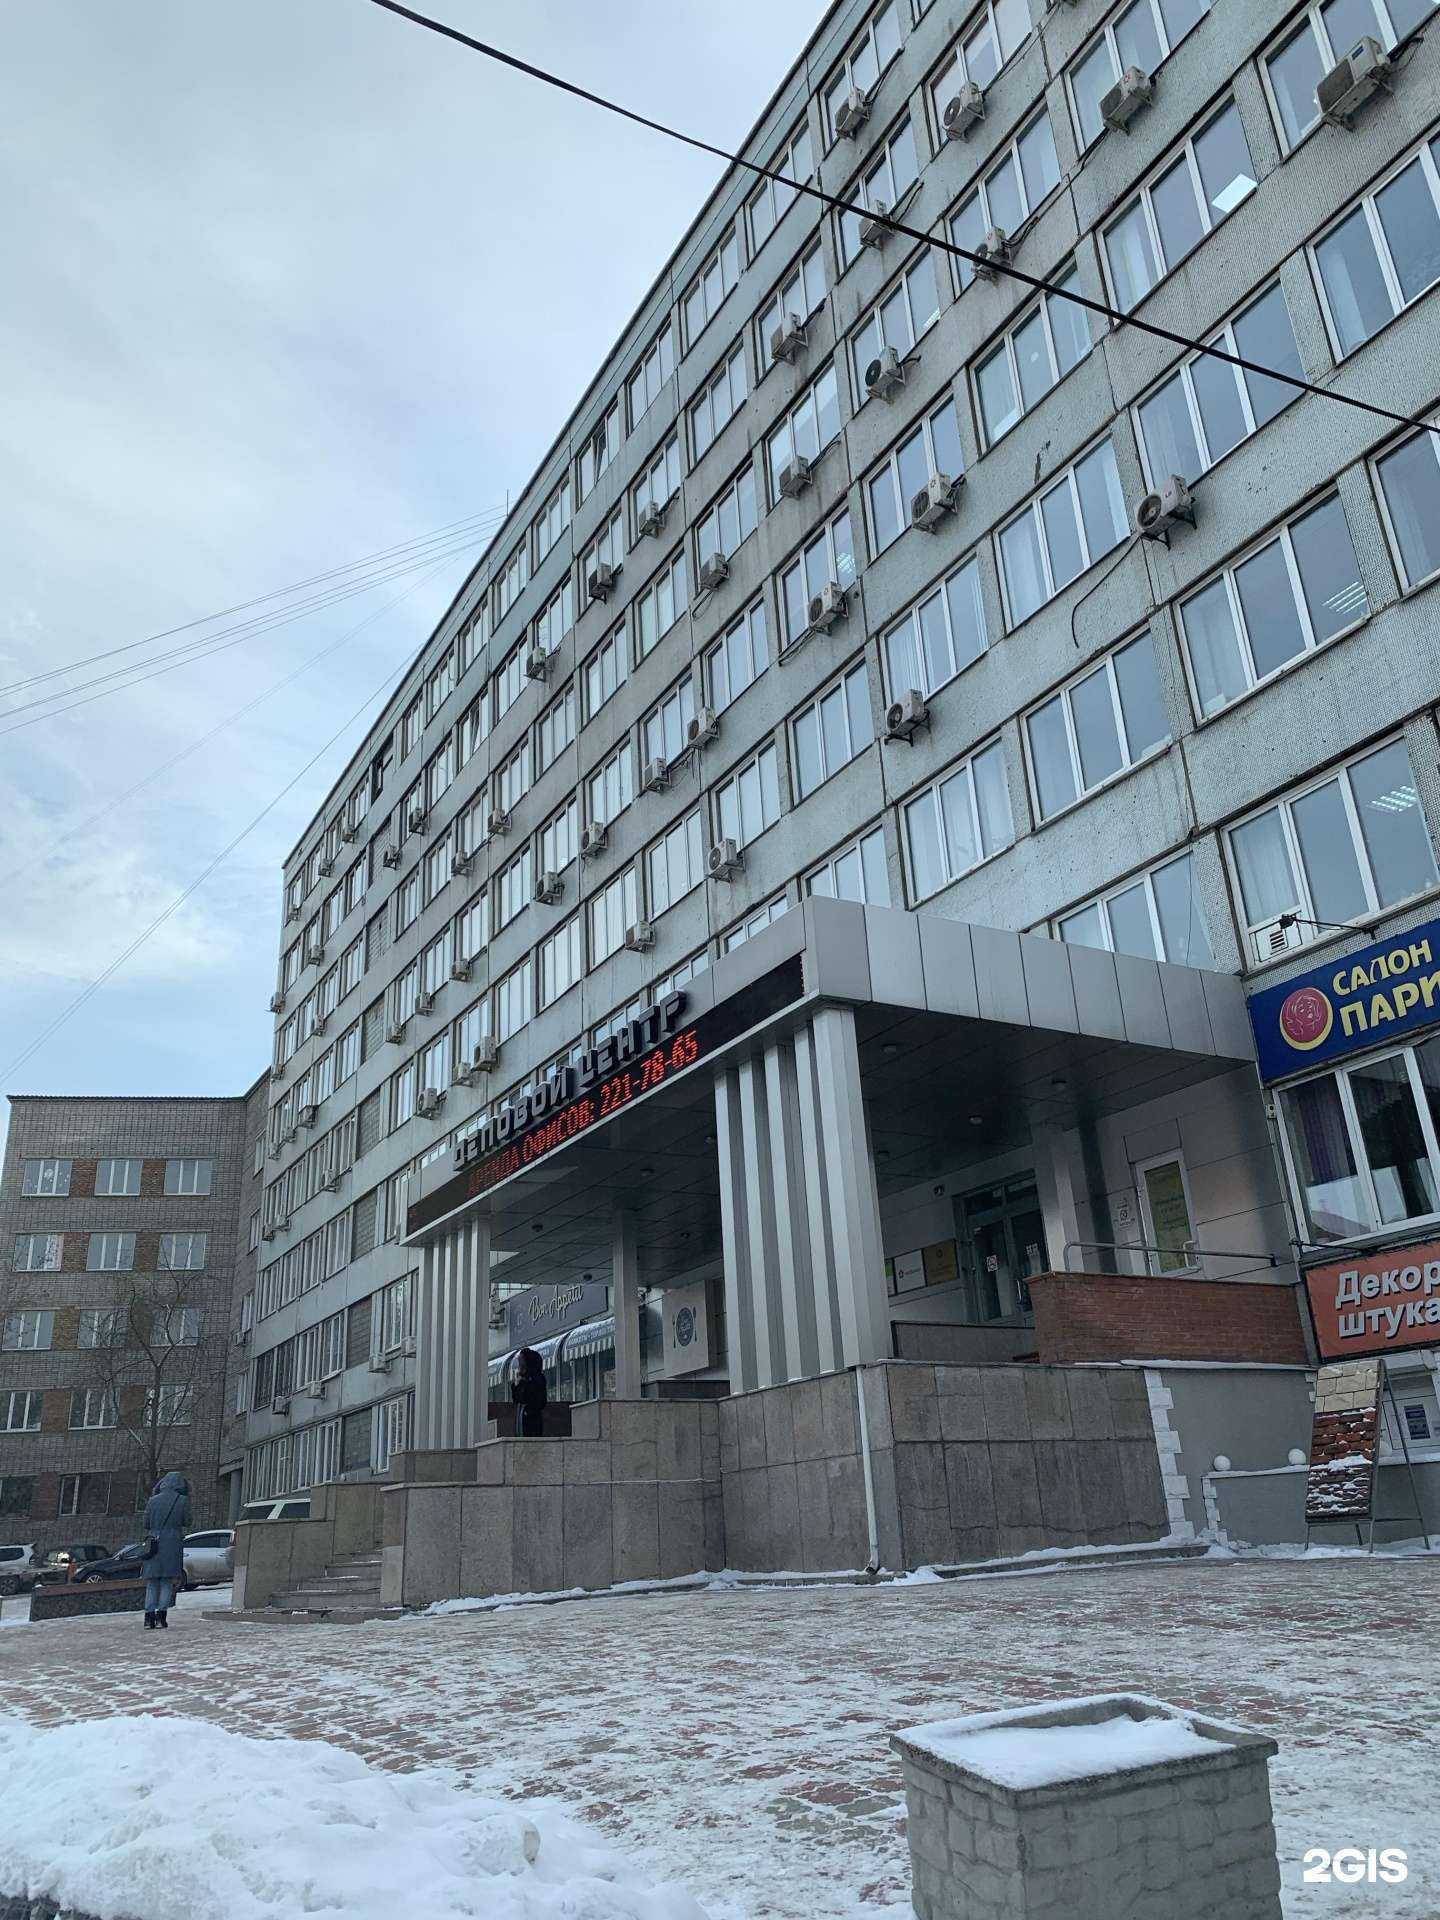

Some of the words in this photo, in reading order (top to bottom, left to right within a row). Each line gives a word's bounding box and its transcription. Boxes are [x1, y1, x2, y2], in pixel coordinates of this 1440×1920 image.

[1332, 938, 1433, 996] САЛОН
[452, 1065, 573, 1171] ДЕЛОВОЙ
[578, 988, 687, 1087] ЦЕНТР
[522, 1098, 594, 1163] ОФИСОВ:
[600, 1029, 699, 1116] 221-78-65
[1335, 1260, 1440, 1310] Декор
[1339, 1297, 1440, 1338] штука
